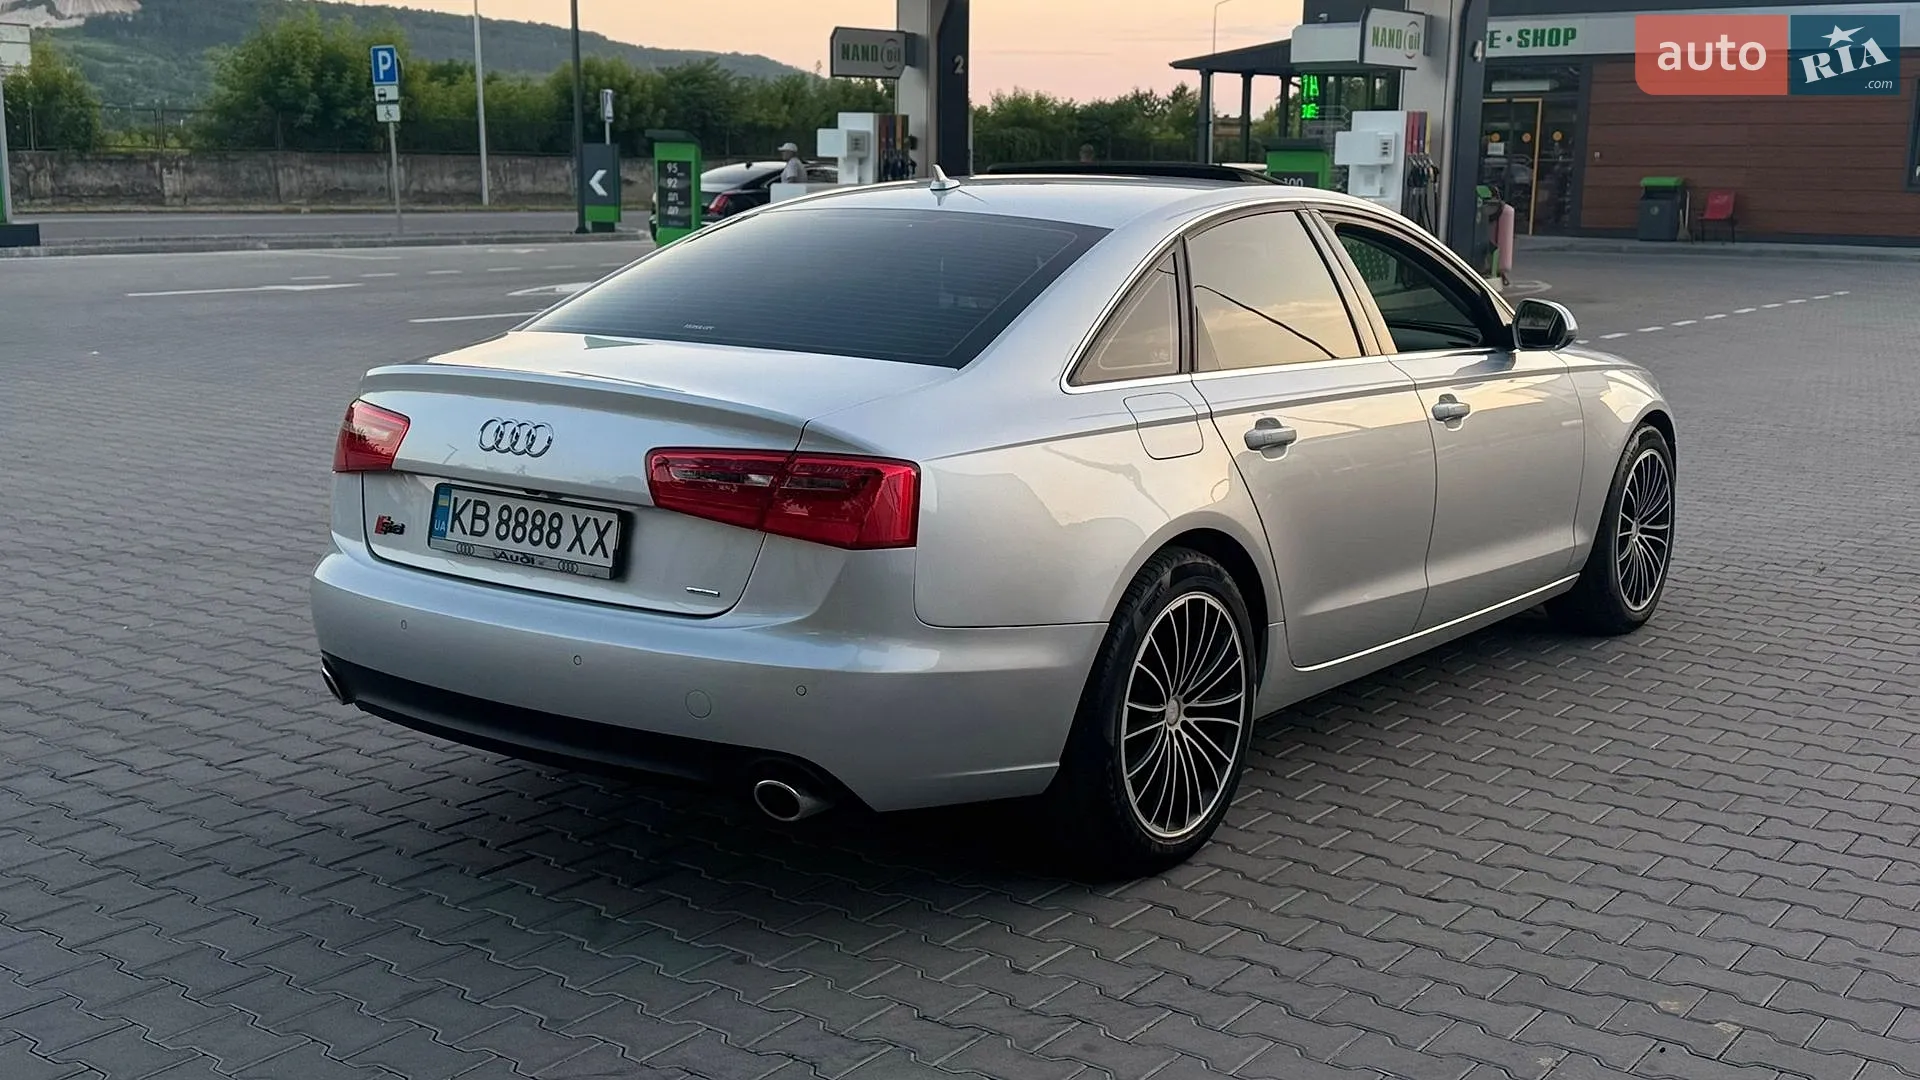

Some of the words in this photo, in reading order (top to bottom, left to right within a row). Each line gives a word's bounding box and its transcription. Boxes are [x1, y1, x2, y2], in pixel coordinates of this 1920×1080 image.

[1371, 26, 1402, 50] NANO
[1517, 27, 1577, 48] SHOP
[841, 43, 879, 63] NANO
[377, 50, 392, 80] P
[953, 55, 965, 74] 2
[666, 162, 678, 174] 95
[666, 178, 678, 189] 92
[434, 520, 446, 532] UA
[450, 496, 491, 538] KB
[495, 504, 564, 549] 8888
[566, 514, 614, 559] XX
[496, 551, 536, 565] Audi
